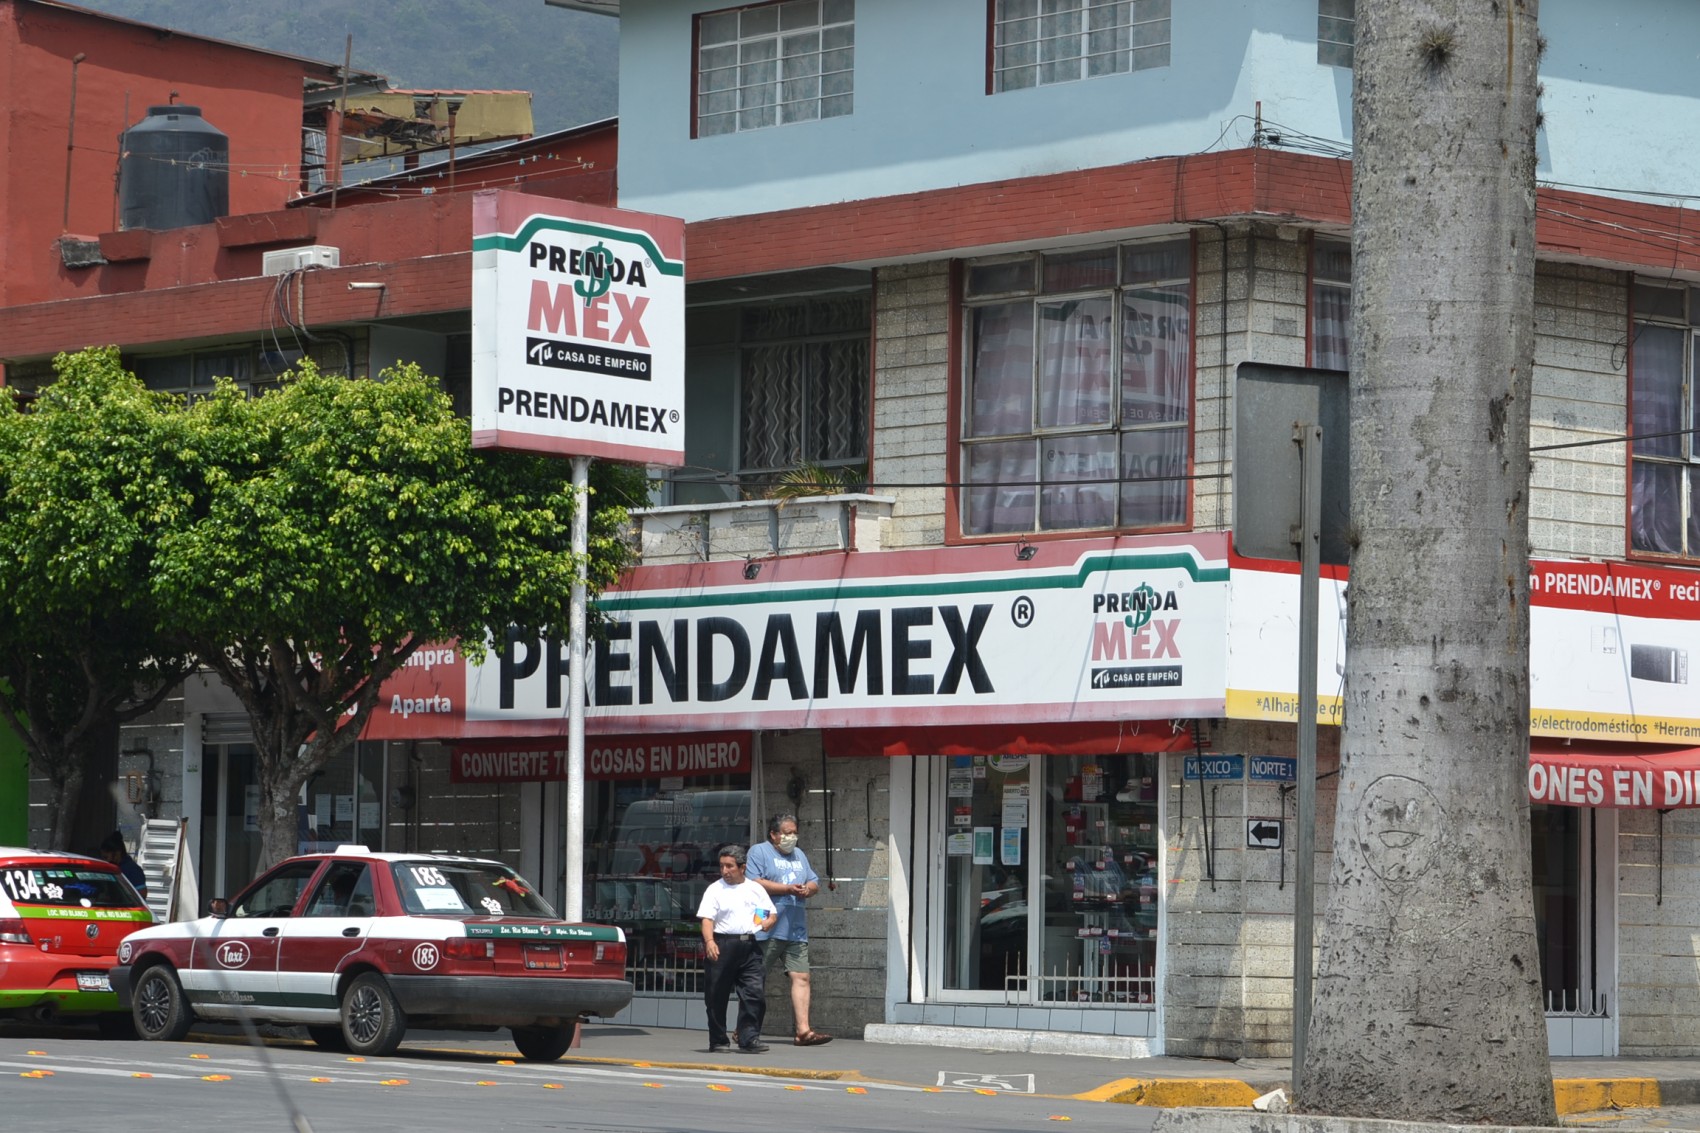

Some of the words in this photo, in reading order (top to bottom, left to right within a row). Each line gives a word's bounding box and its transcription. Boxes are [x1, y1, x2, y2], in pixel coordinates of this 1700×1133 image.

[530, 241, 647, 288] PRENDA
[527, 279, 651, 348] MEX
[530, 342, 553, 365] Tu
[557, 349, 585, 364] CASA
[588, 354, 602, 366] DE
[604, 356, 648, 373] EMPEÑO
[1669, 578, 1700, 601] reci
[1093, 590, 1179, 614] PRENDA
[1091, 619, 1182, 661] MEX
[1093, 669, 1111, 688] Tu
[1113, 673, 1133, 682] CASA
[1135, 673, 1145, 681] DE
[1147, 670, 1179, 681] EMPEÑO
[390, 694, 452, 719] Aparta
[1256, 697, 1299, 716] Alhaja
[1317, 703, 1326, 715] e
[461, 751, 549, 778] CONVIERTE
[590, 747, 645, 775] COSAS
[650, 745, 672, 772] EN
[677, 741, 741, 771] DINERO
[1186, 761, 1231, 775] MEXICO
[1251, 762, 1287, 776] NORTE
[1288, 764, 1293, 777] 1
[1529, 763, 1604, 805] ONES
[1613, 770, 1654, 806] EN
[4, 870, 42, 900] 134
[411, 866, 446, 887] 185
[223, 946, 244, 963] Taxi
[416, 948, 435, 965] 185
